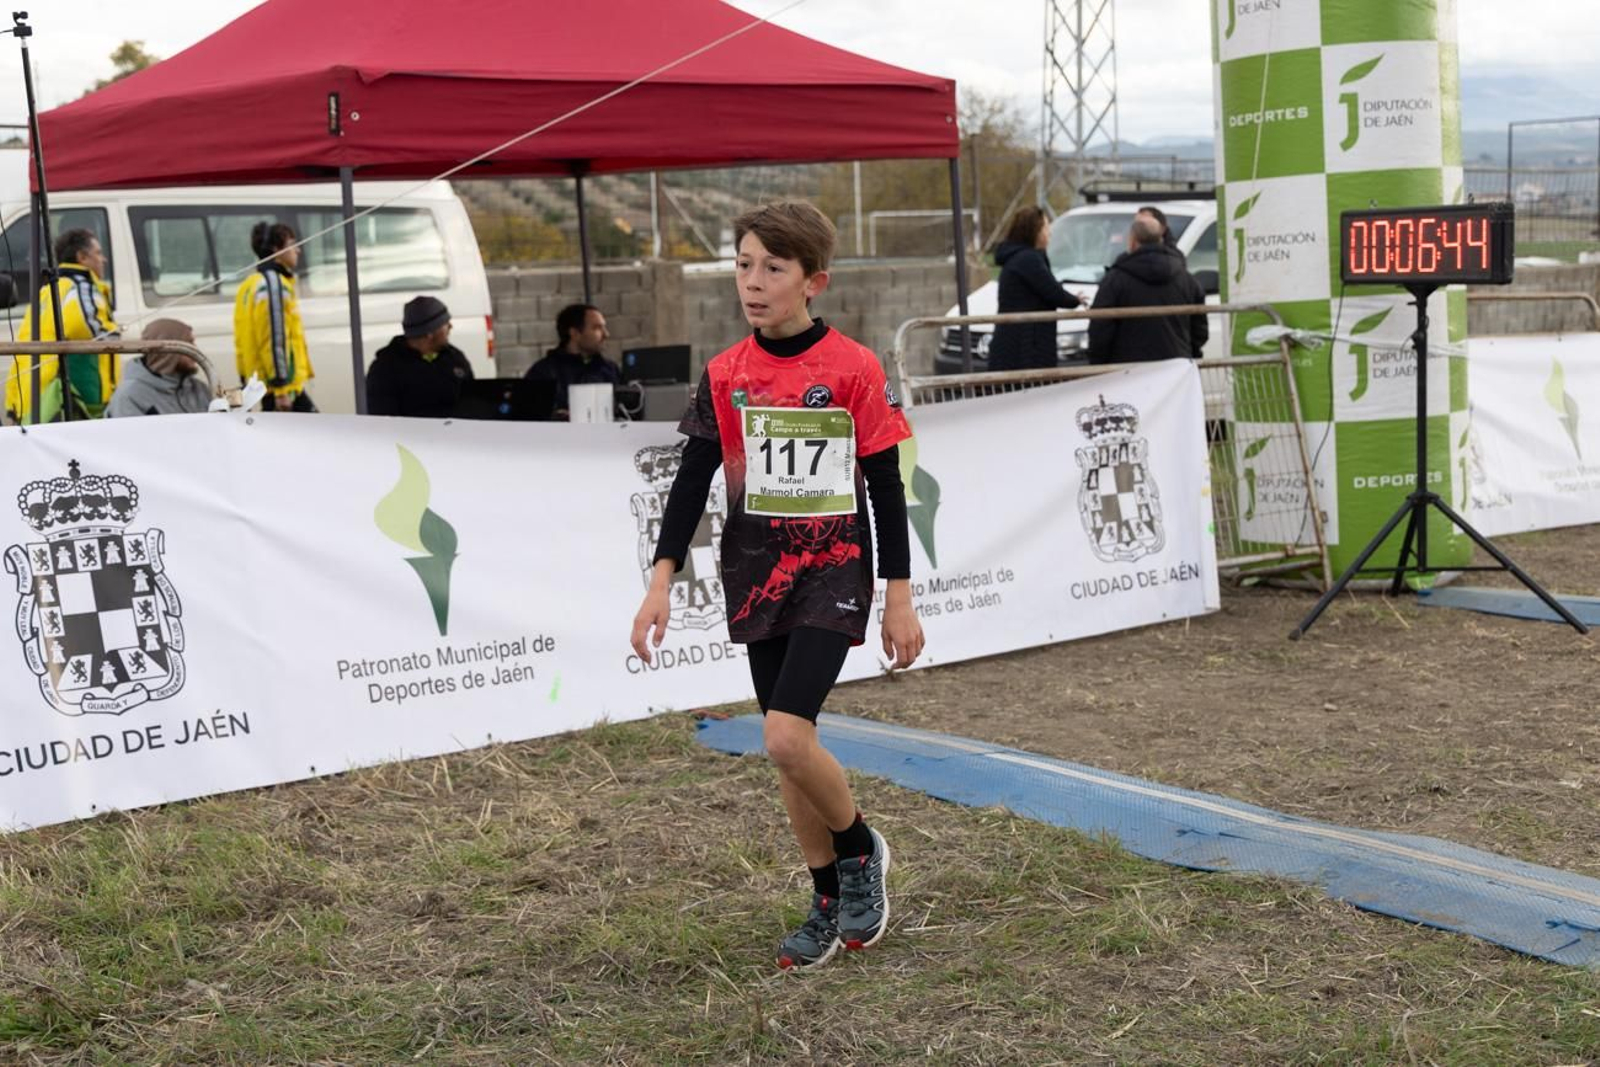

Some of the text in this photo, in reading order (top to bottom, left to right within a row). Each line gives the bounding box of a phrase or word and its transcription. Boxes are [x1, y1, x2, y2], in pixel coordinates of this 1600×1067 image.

[1363, 98, 1432, 112] DIPUTACIÓN
[1229, 106, 1308, 127] DEPORTES
[1364, 113, 1414, 128] DE JAÉN
[1247, 232, 1316, 247] DIPUTACIÓN
[1350, 218, 1487, 274] 00:06:44
[1247, 248, 1290, 263] DE JAÉN
[1372, 367, 1390, 379] DE
[760, 438, 828, 476] 117
[778, 476, 805, 485] Rafael
[1354, 471, 1442, 489] DEPORES
[760, 486, 834, 498] Marmol Camara
[928, 567, 1014, 594] Municipal de
[1070, 574, 1133, 600] CIUDAD
[1136, 569, 1158, 588] DE
[945, 598, 964, 613] de
[968, 590, 1002, 610] Jaén
[336, 634, 556, 680] Patronato Municipal de
[708, 640, 736, 662] DE
[368, 662, 535, 705] Deportes de Jaén
[0, 709, 250, 776] CIUDAD DE JAÉN
